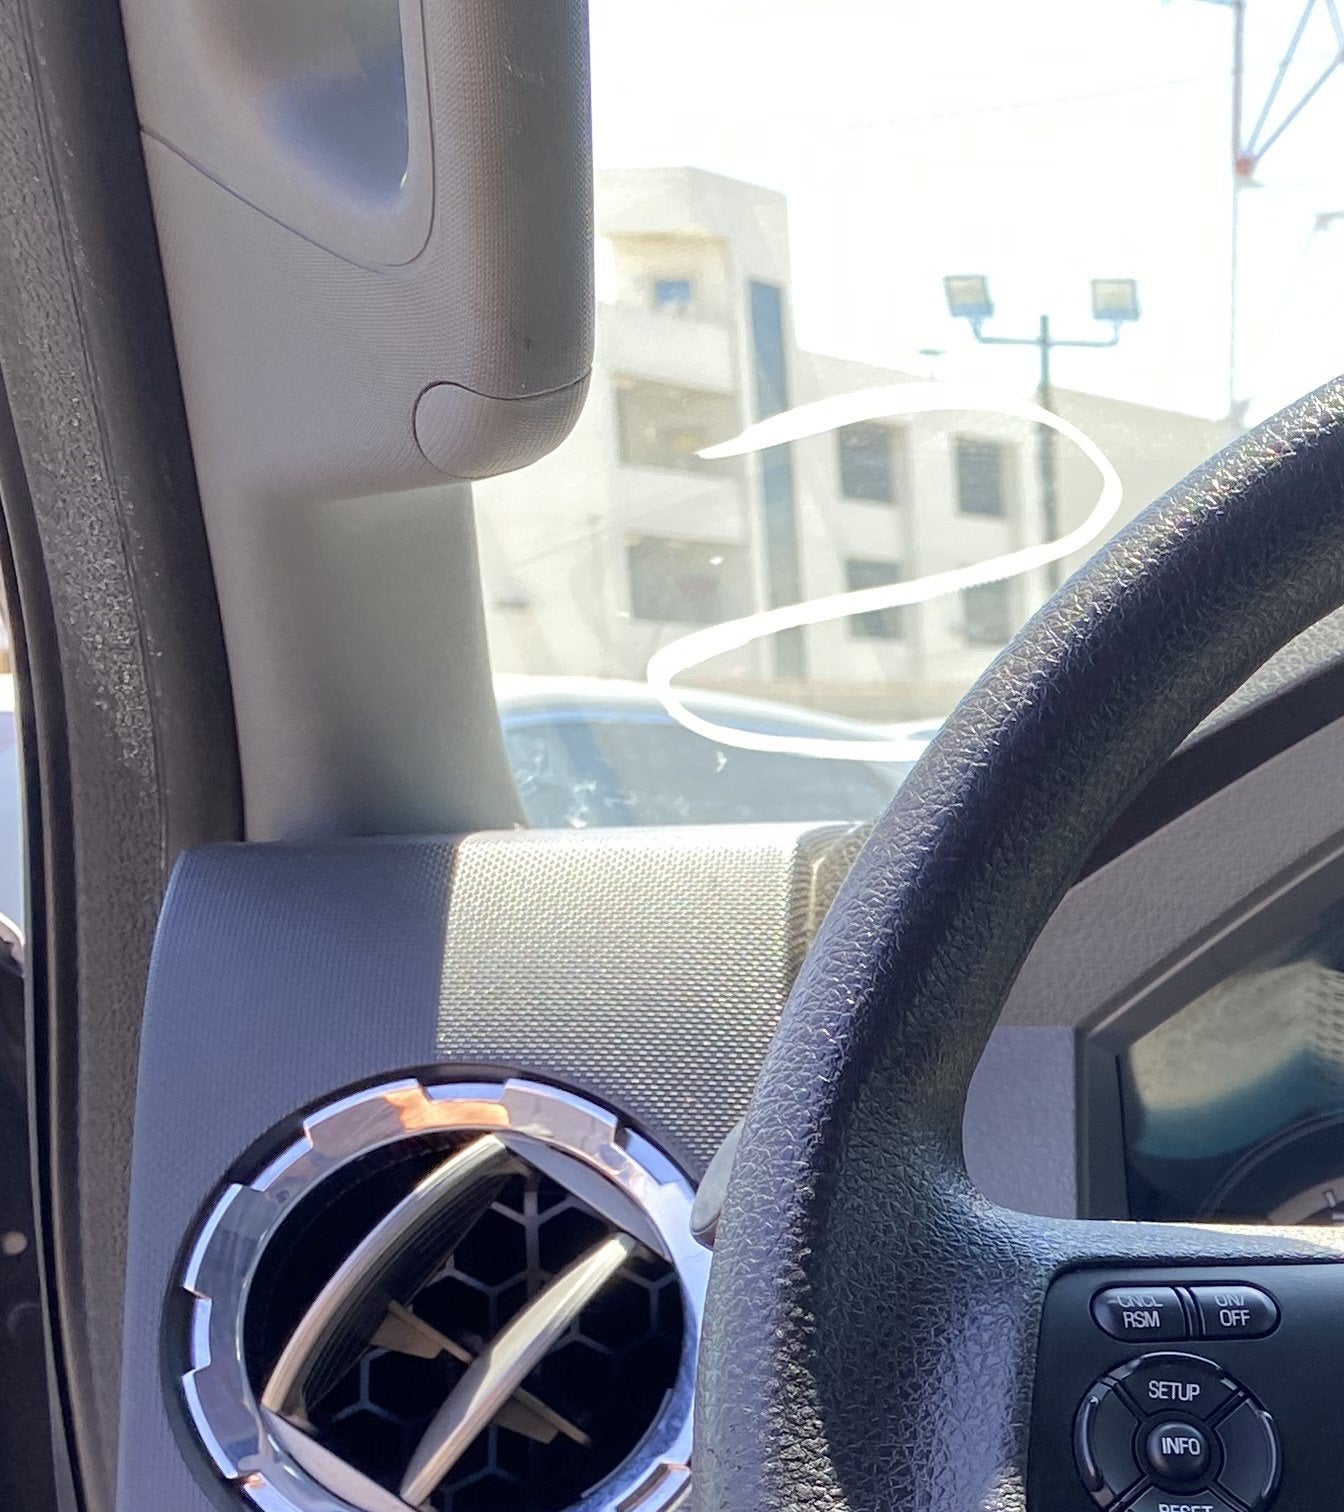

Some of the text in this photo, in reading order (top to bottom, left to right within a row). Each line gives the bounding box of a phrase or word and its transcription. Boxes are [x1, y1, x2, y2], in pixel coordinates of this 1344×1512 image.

[1122, 1310, 1161, 1329] RSM
[1219, 1309, 1250, 1327] OFF
[1147, 1379, 1201, 1402] SETUP
[1160, 1436, 1201, 1457] INFO
